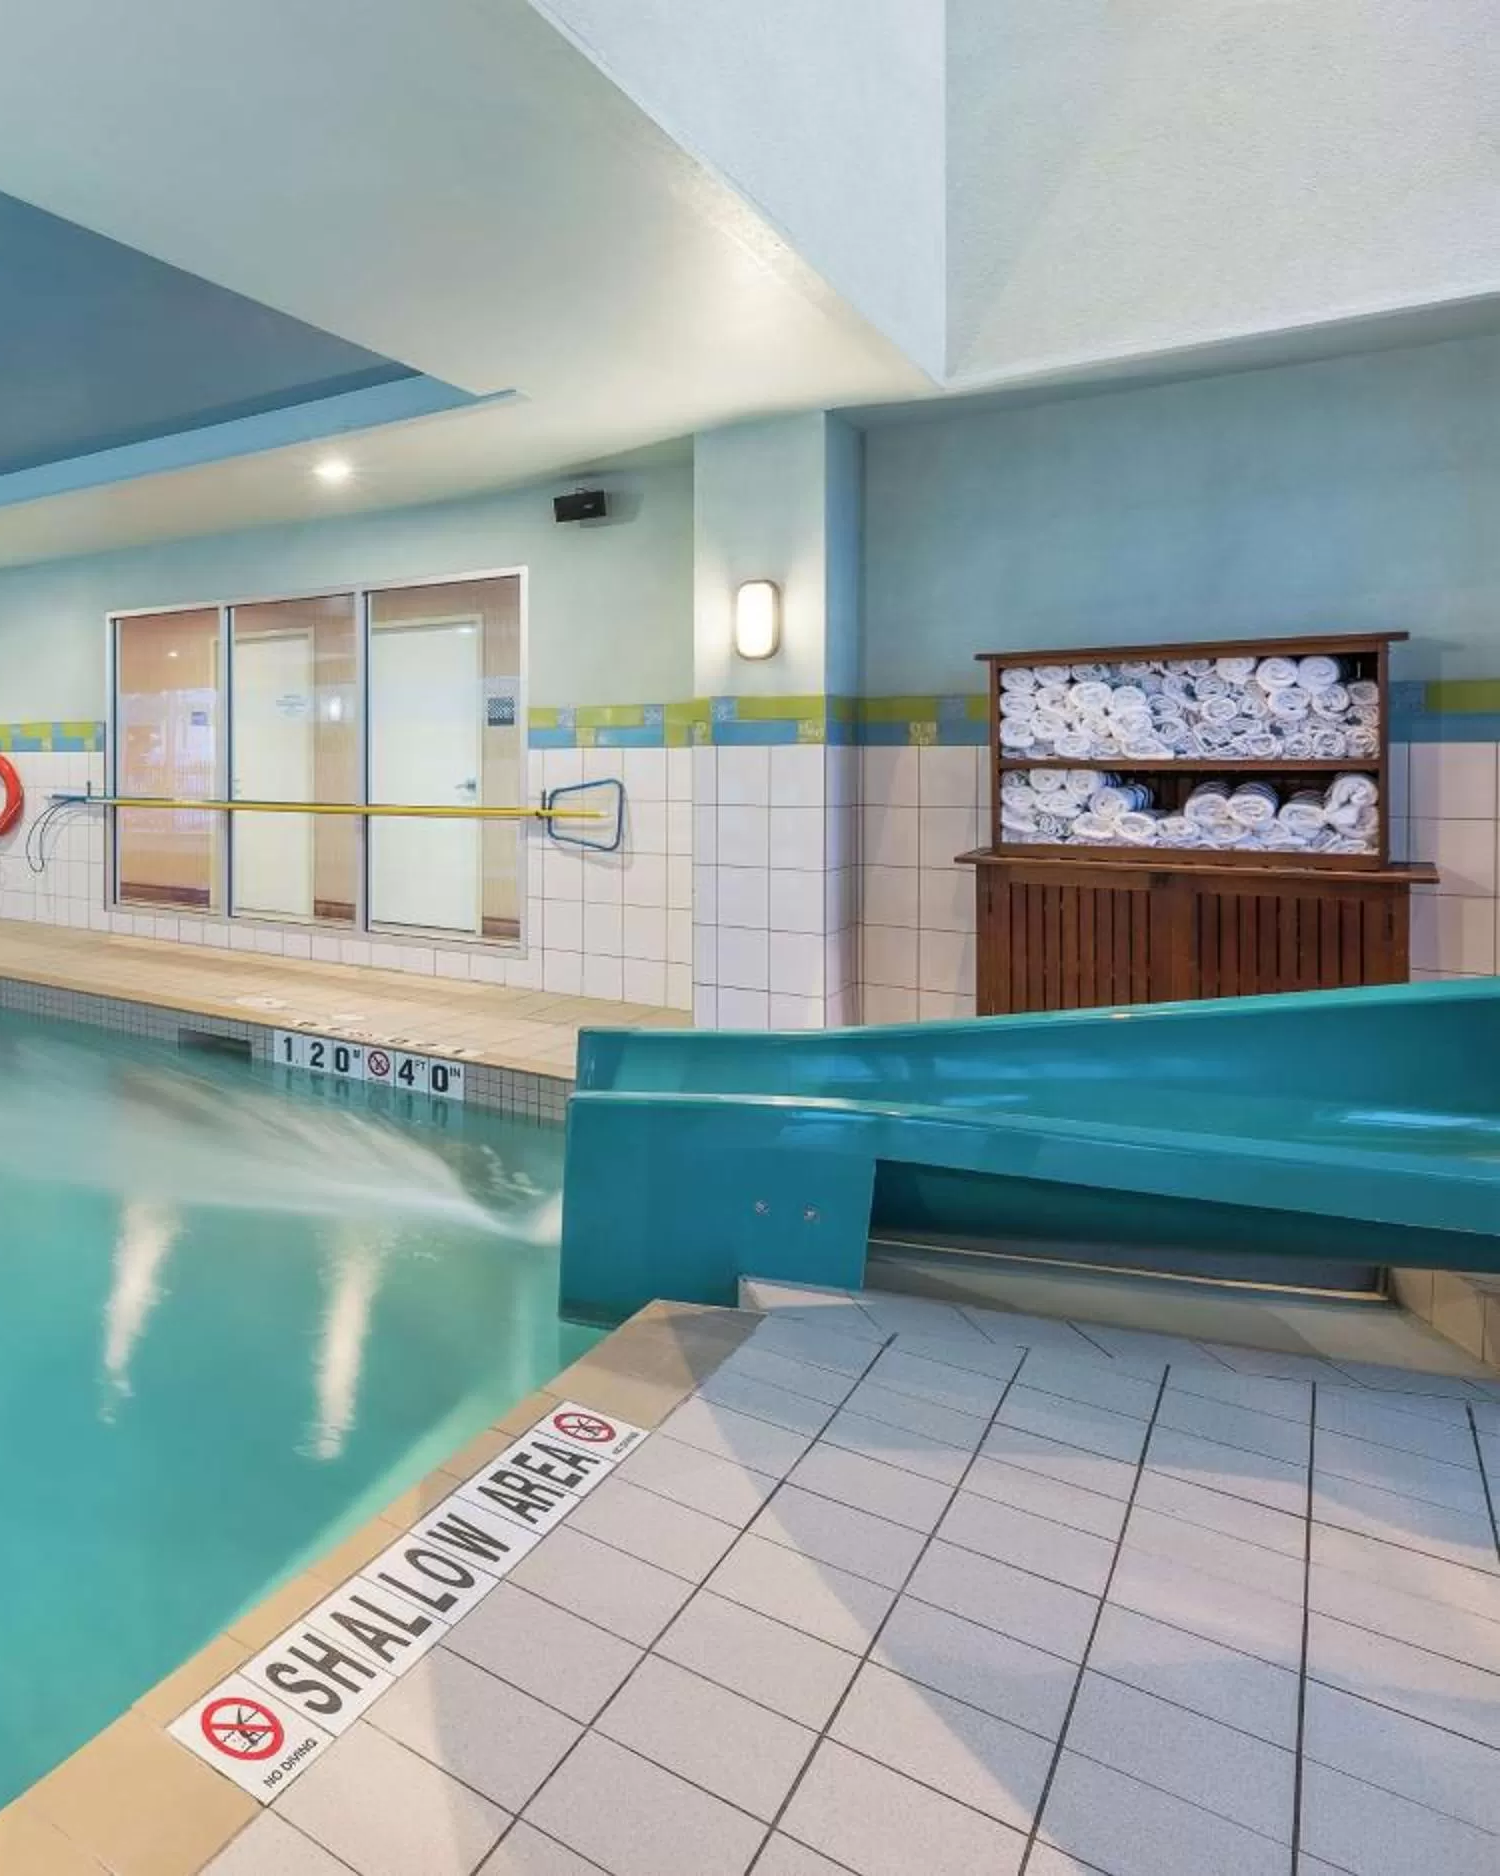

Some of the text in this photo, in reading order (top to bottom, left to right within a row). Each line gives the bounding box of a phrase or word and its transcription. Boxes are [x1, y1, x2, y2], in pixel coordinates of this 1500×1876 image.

[265, 1441, 601, 1715] SHALLOW AREA
[263, 1770, 283, 1788] NO
